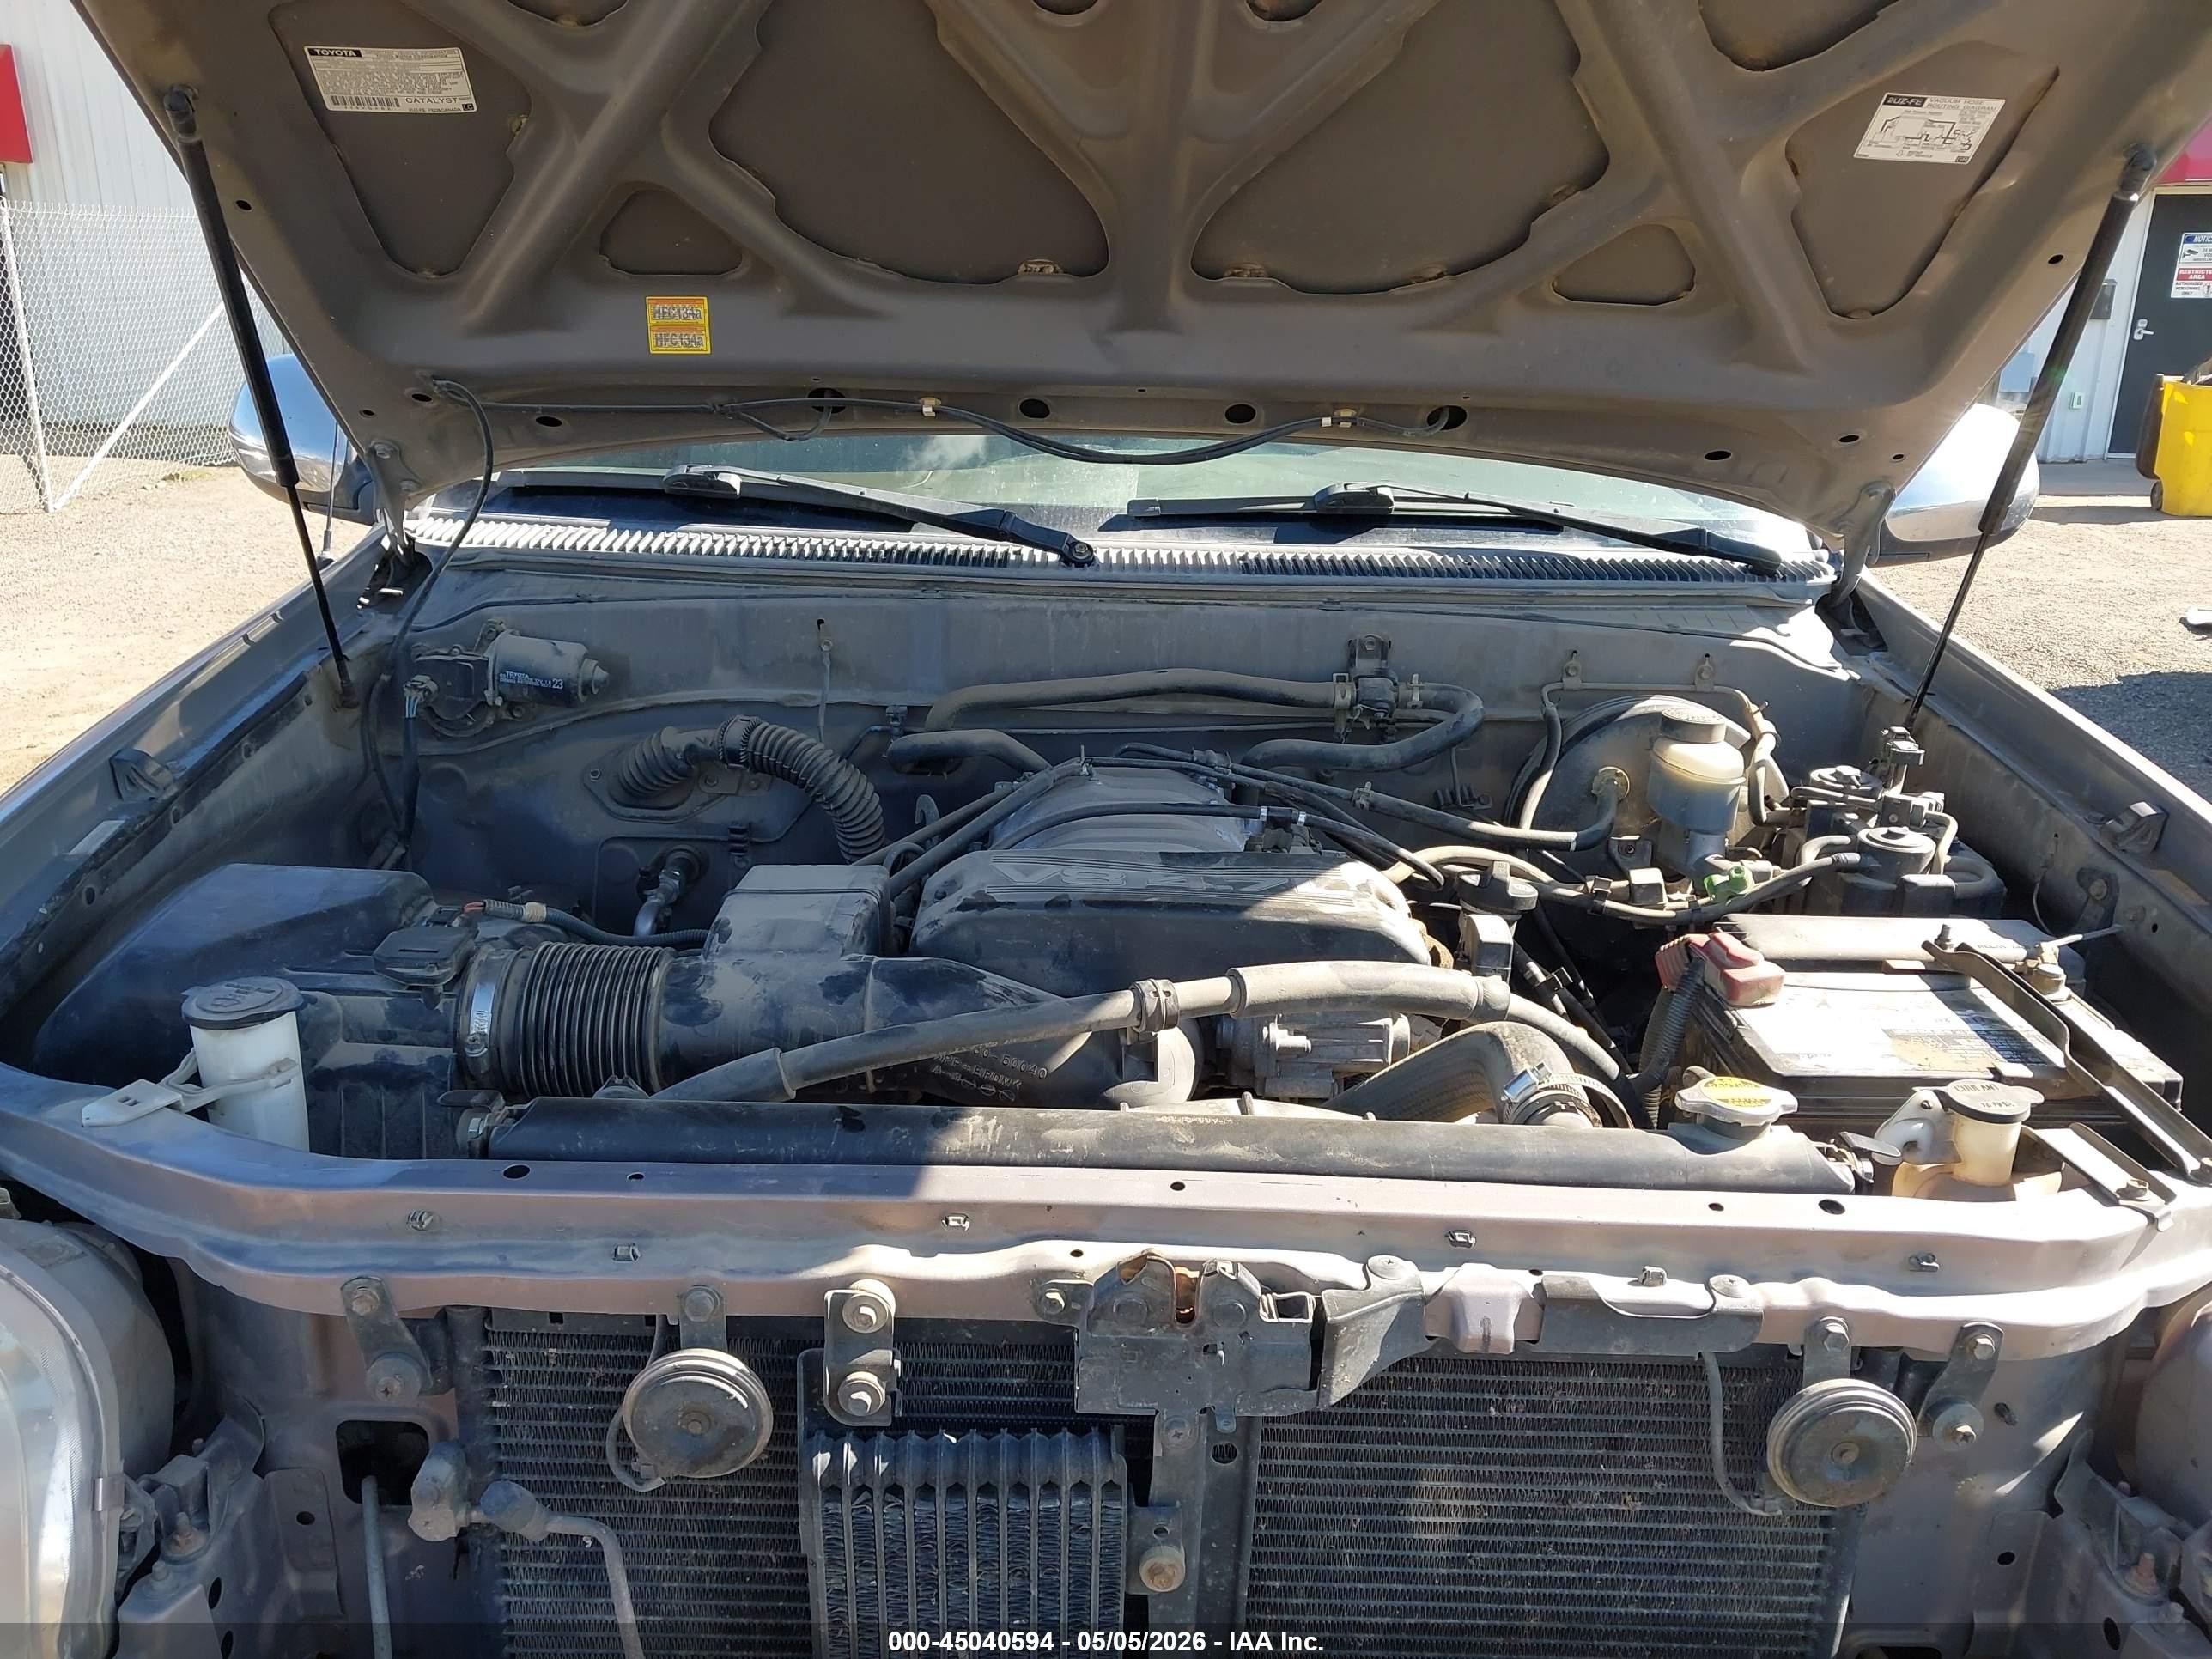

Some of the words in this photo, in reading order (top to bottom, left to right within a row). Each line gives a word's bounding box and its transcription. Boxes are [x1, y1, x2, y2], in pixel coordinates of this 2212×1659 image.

[552, 678, 563, 690] 23
[990, 863, 1126, 886] V8
[1954, 1084, 1999, 1092] COOLANT
